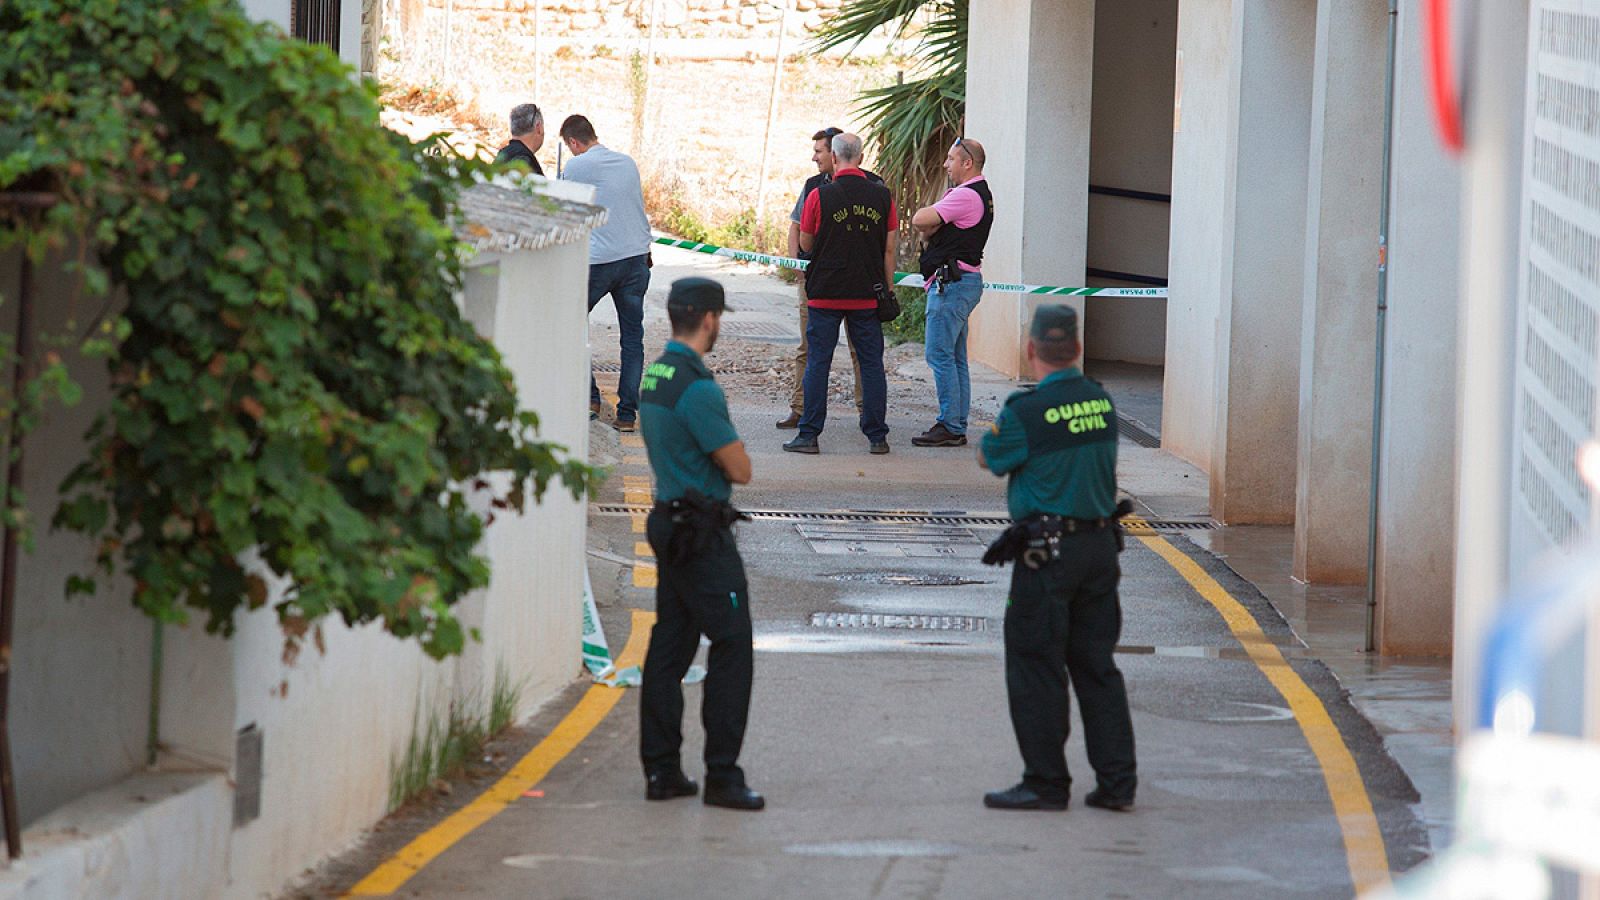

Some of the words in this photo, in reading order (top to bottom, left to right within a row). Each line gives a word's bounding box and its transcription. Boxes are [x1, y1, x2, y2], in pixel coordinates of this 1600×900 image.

[833, 205, 865, 223] GUADIA
[733, 251, 757, 263] PASAR
[759, 255, 771, 265] NO
[779, 258, 797, 269] CIVIL
[992, 283, 1026, 292] GUARDIA
[1119, 288, 1144, 296] PASAR
[1145, 288, 1157, 296] NO
[1044, 398, 1112, 423] GUARDIA
[1068, 414, 1108, 434] CIVIL
